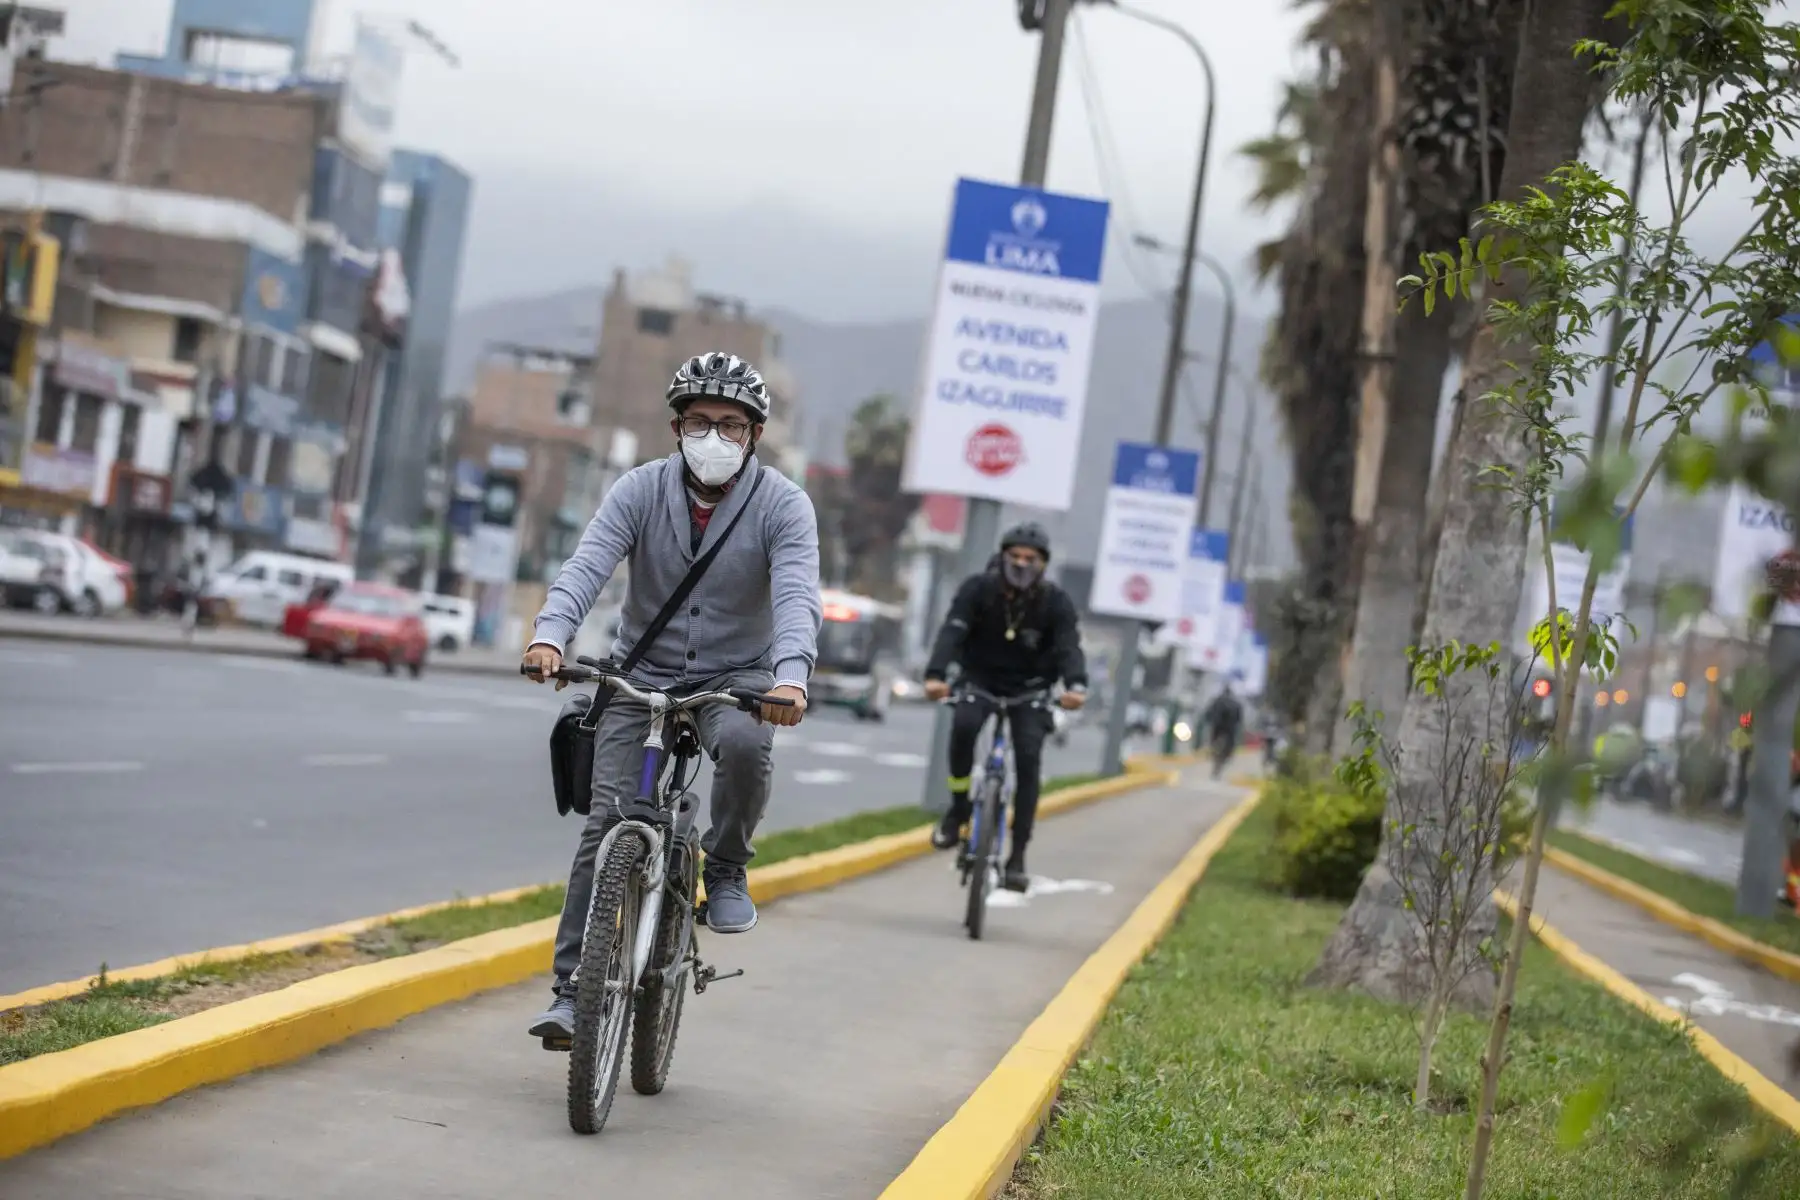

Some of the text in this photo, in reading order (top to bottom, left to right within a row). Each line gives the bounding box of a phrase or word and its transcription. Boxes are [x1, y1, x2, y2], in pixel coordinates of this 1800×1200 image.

[985, 242, 1061, 276] LIMA
[953, 315, 1070, 353] AVENIDA
[957, 348, 1059, 386] CARLOS
[936, 378, 1068, 420] IZAGUIRRE
